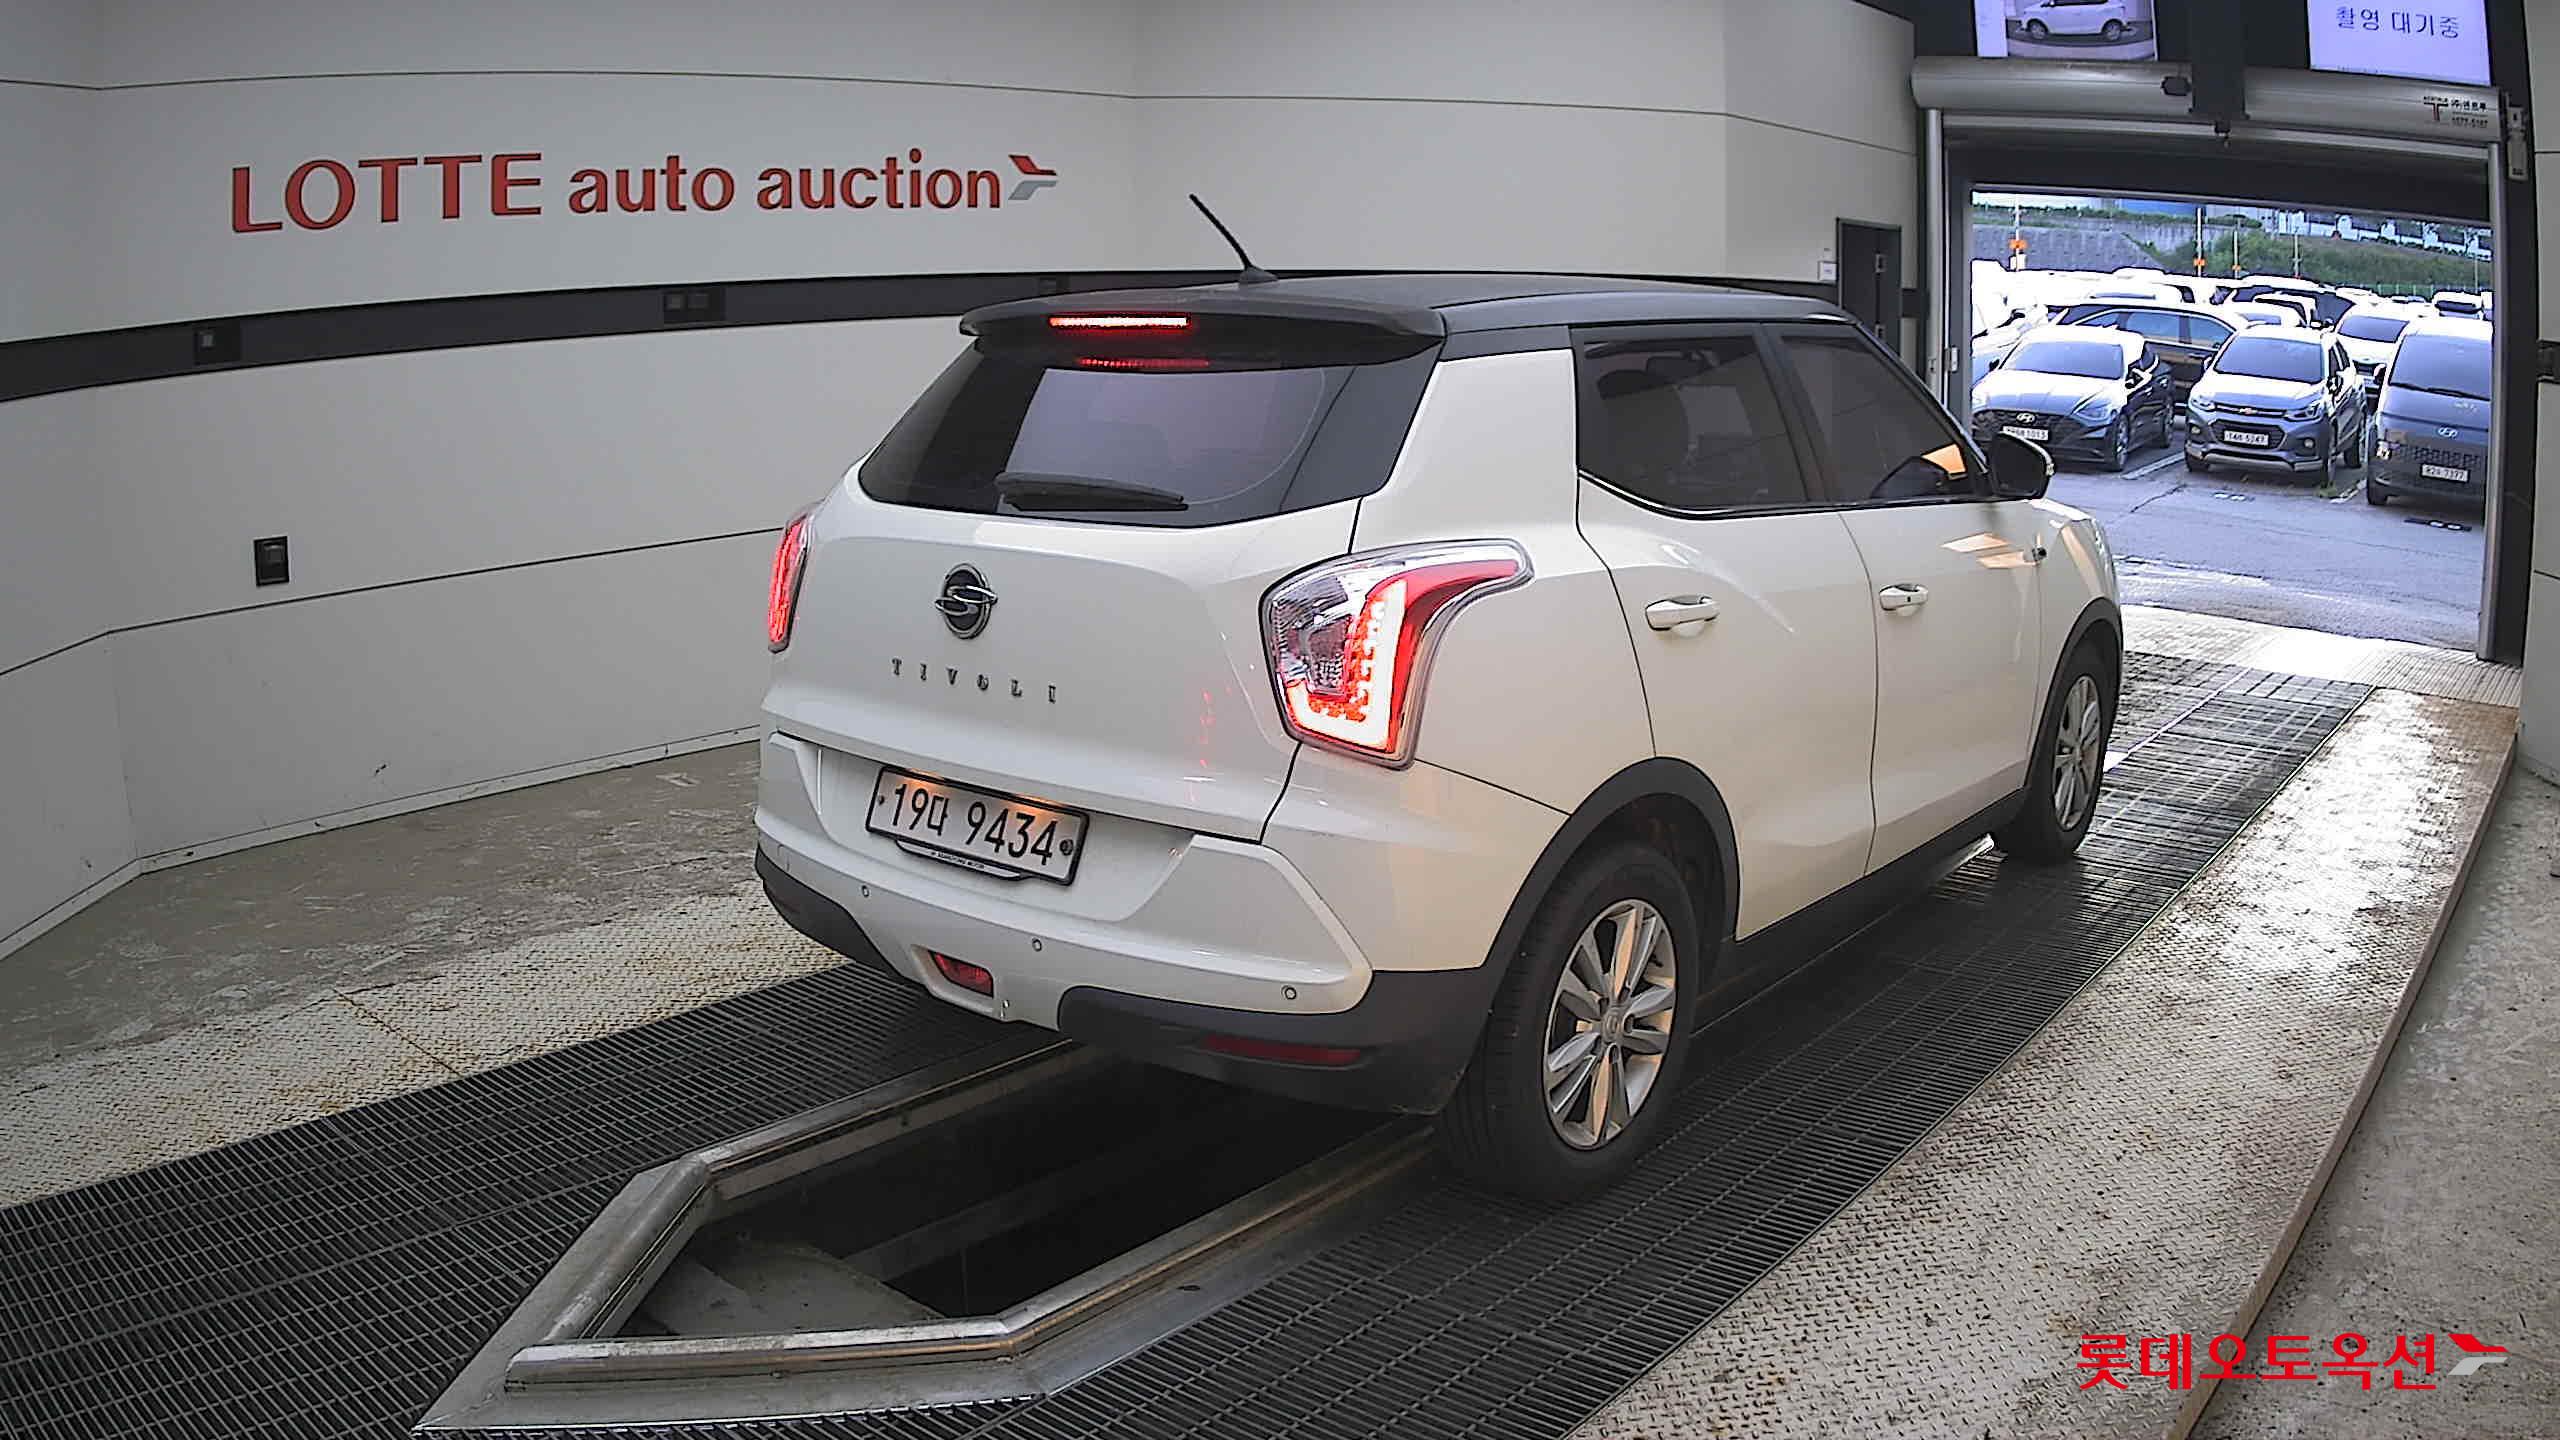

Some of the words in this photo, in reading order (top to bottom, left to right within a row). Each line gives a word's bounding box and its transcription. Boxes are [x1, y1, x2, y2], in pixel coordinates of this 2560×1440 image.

[2336, 6, 2381, 31] 촬영
[2391, 12, 2460, 39] 대기중
[231, 152, 542, 234] LOTTE
[567, 154, 736, 214] auto
[756, 147, 1001, 210] auction
[891, 657, 1057, 704] TIVOLI
[964, 801, 1059, 866] 9434
